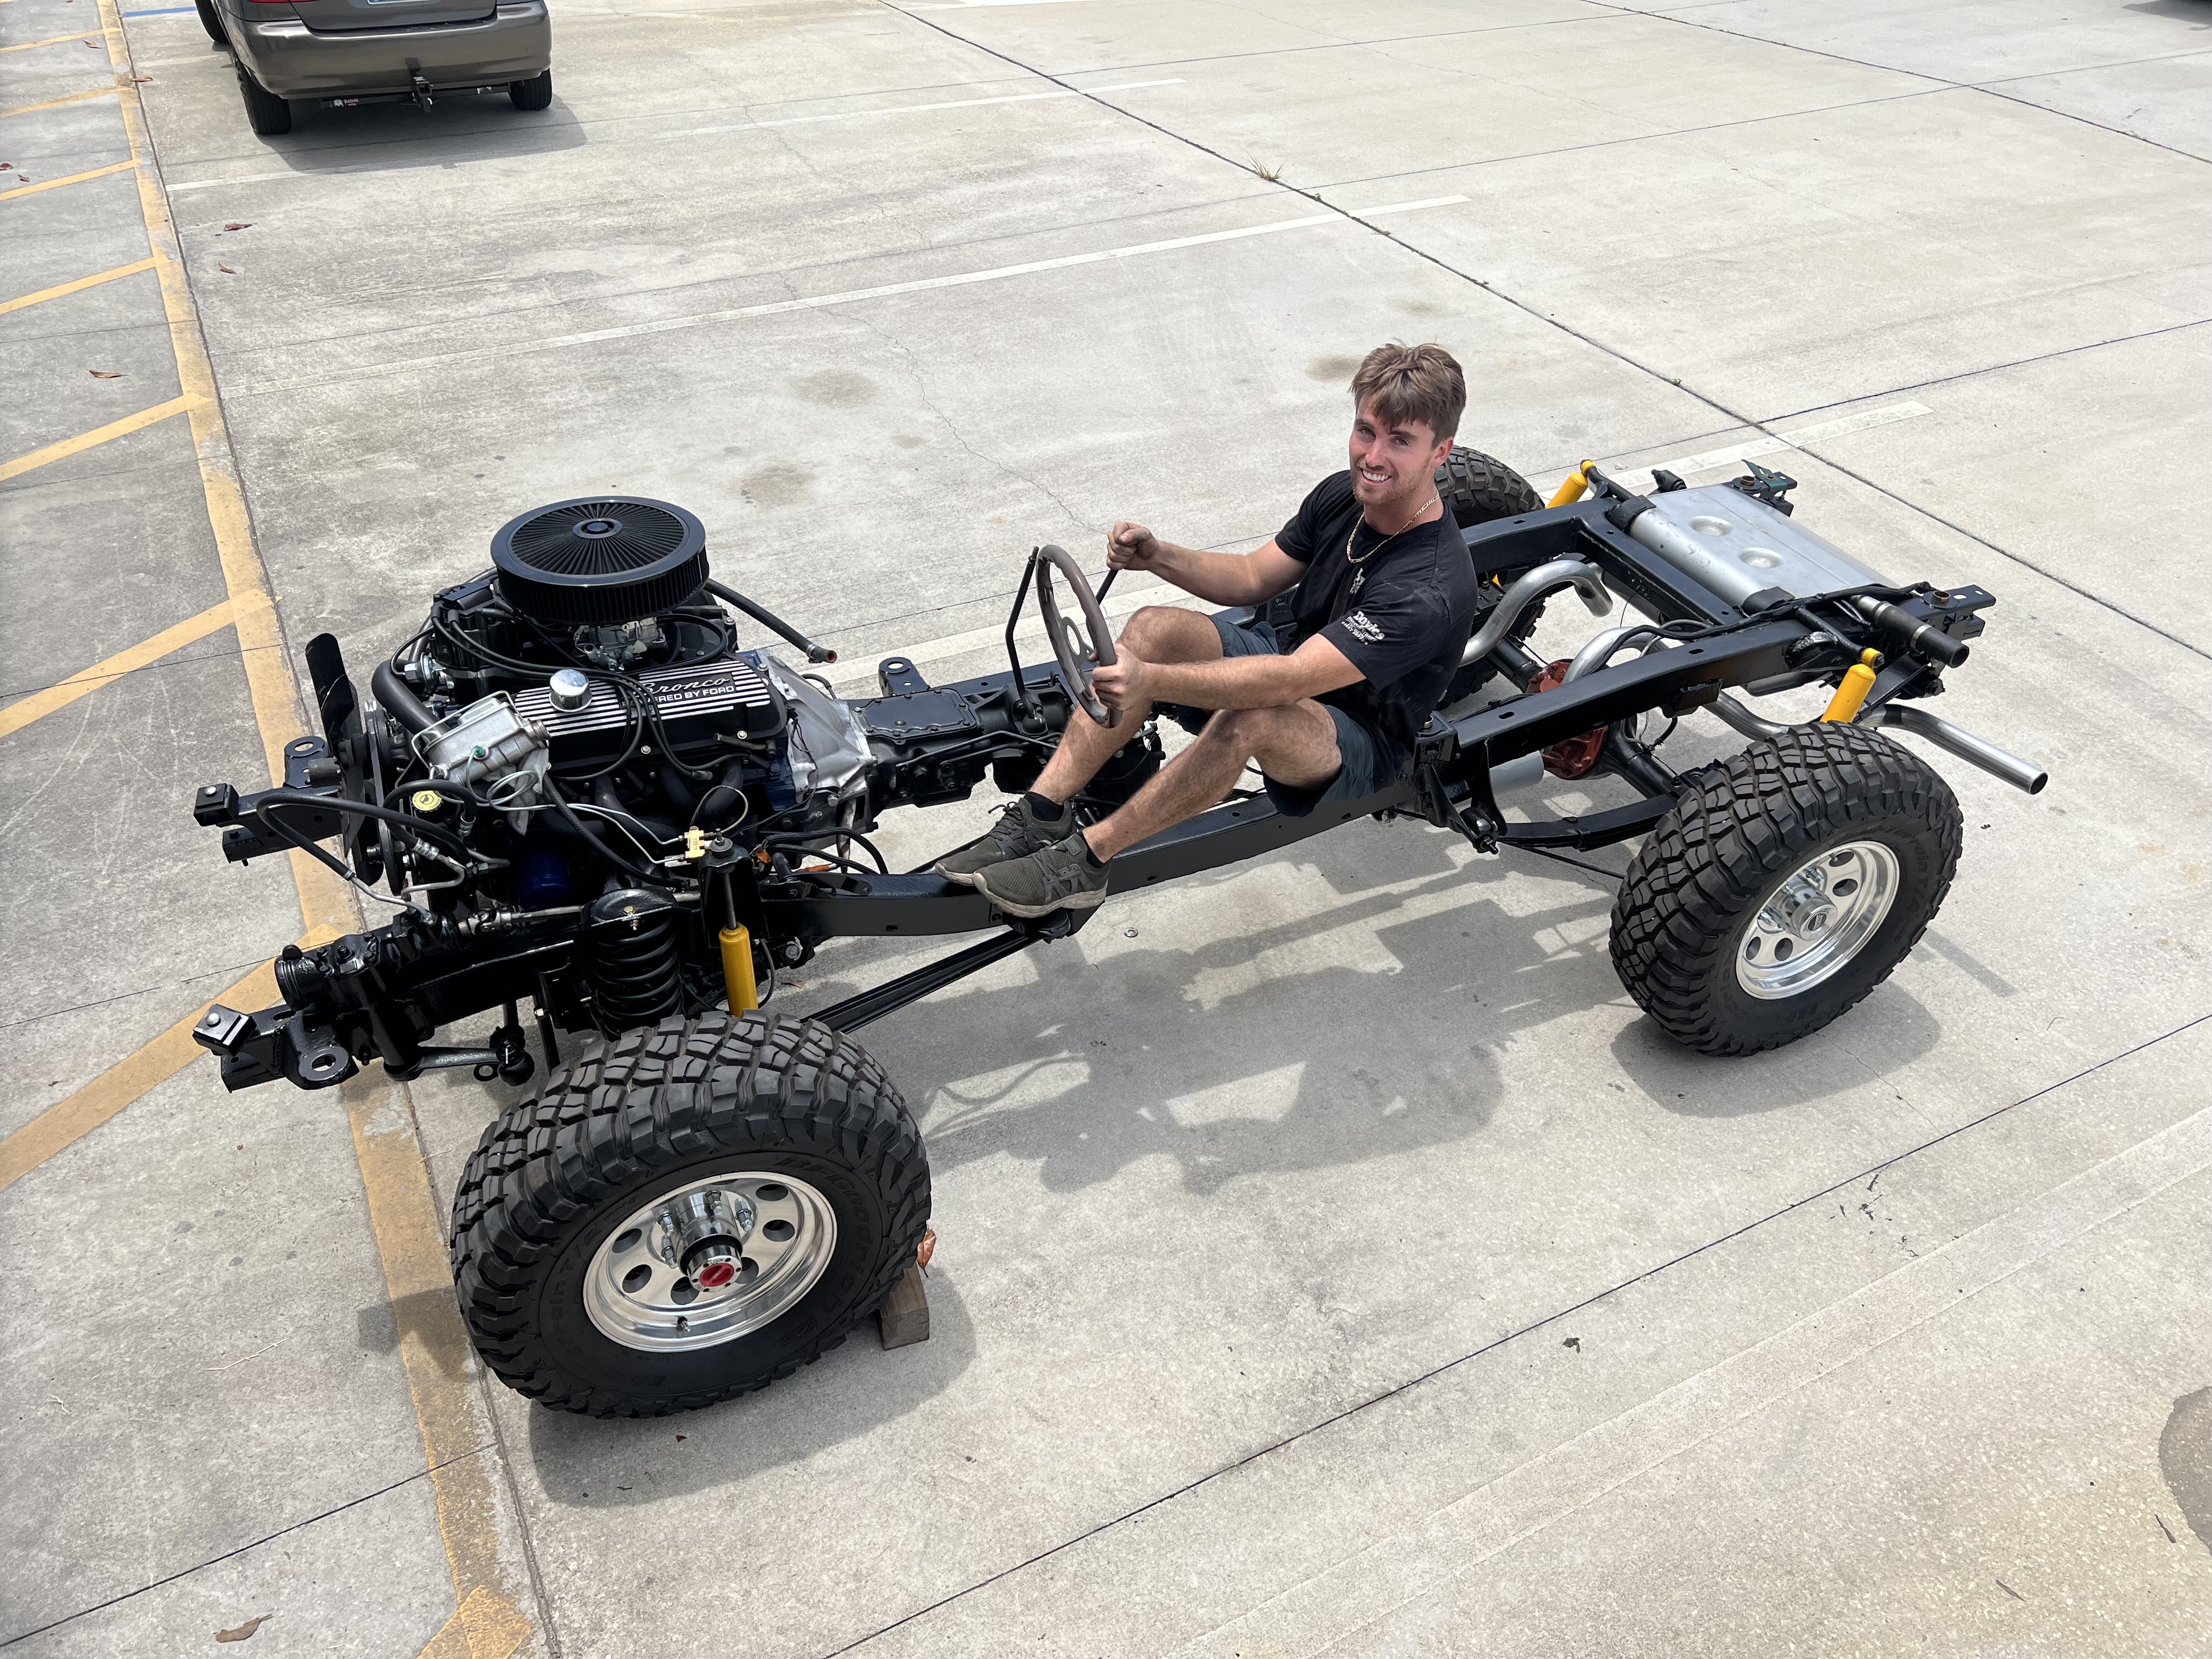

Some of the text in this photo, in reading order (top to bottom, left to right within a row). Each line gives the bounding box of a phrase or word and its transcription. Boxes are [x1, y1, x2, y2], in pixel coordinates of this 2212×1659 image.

[1353, 611, 1385, 640] Doyles
[637, 678, 731, 695] Bronco
[684, 690, 700, 699] BY
[702, 686, 735, 696] FORD
[775, 1156, 873, 1313] BFGoodrich
